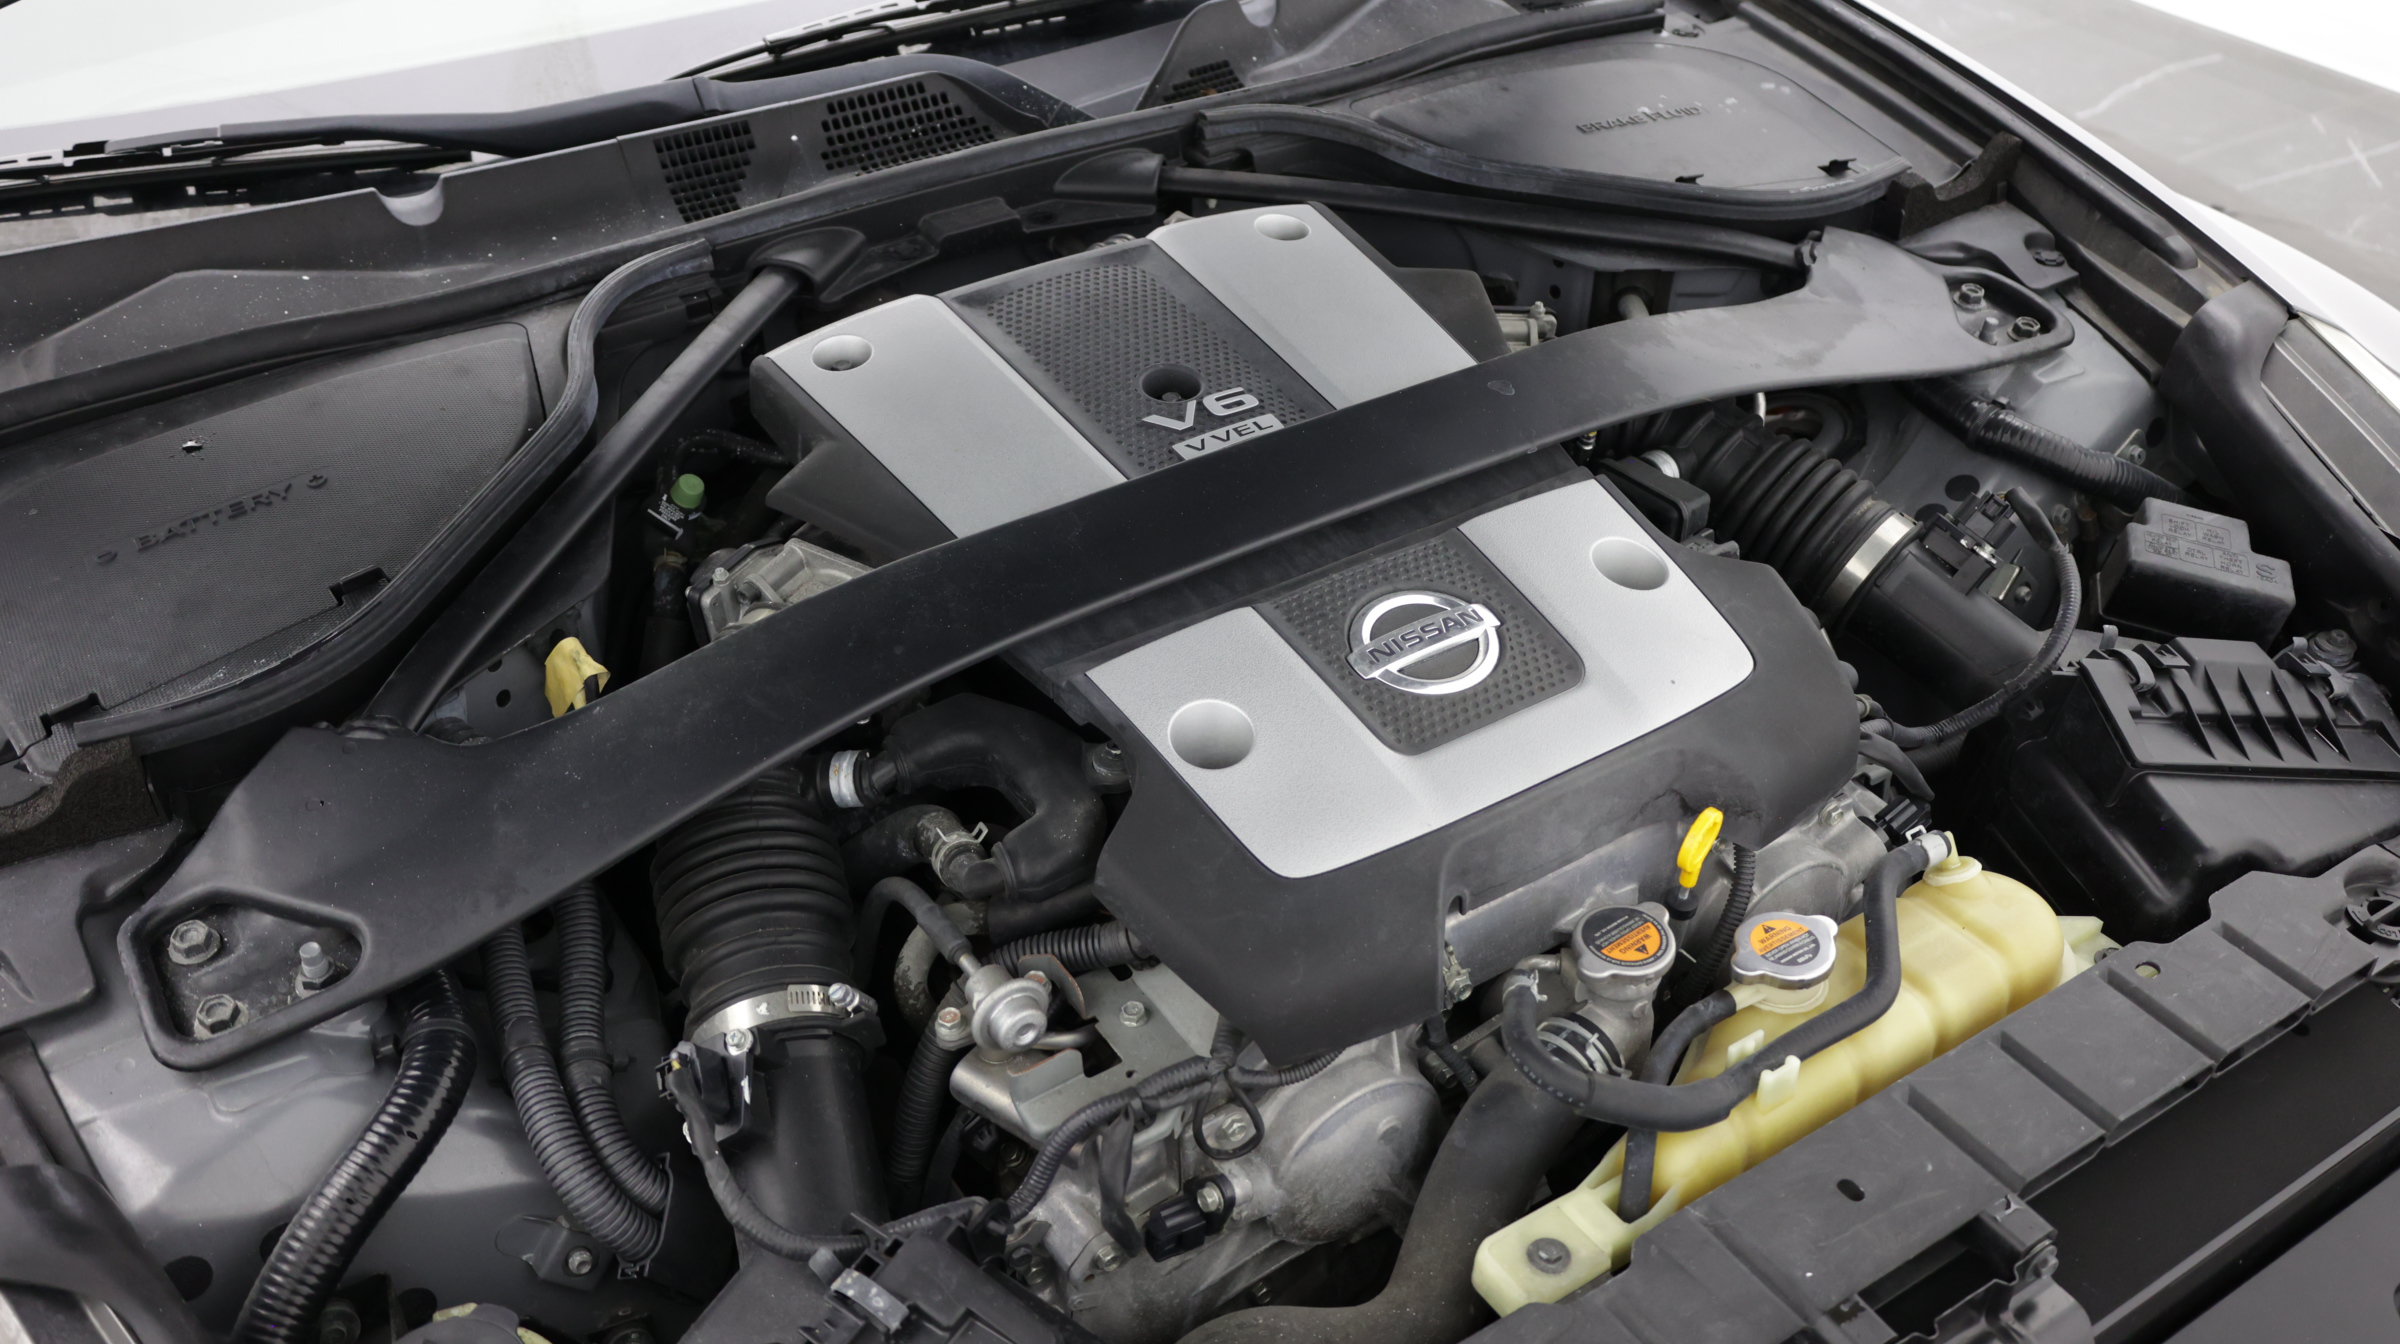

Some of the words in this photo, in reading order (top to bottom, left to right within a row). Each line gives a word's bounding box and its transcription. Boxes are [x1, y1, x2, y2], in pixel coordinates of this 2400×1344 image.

[1576, 115, 1648, 134] BRAKE
[1642, 106, 1703, 122] FLUID
[1141, 386, 1260, 431] V6
[1184, 420, 1274, 452] VVEL
[132, 482, 293, 552] BATTERY
[1366, 607, 1485, 664] NISSAN
